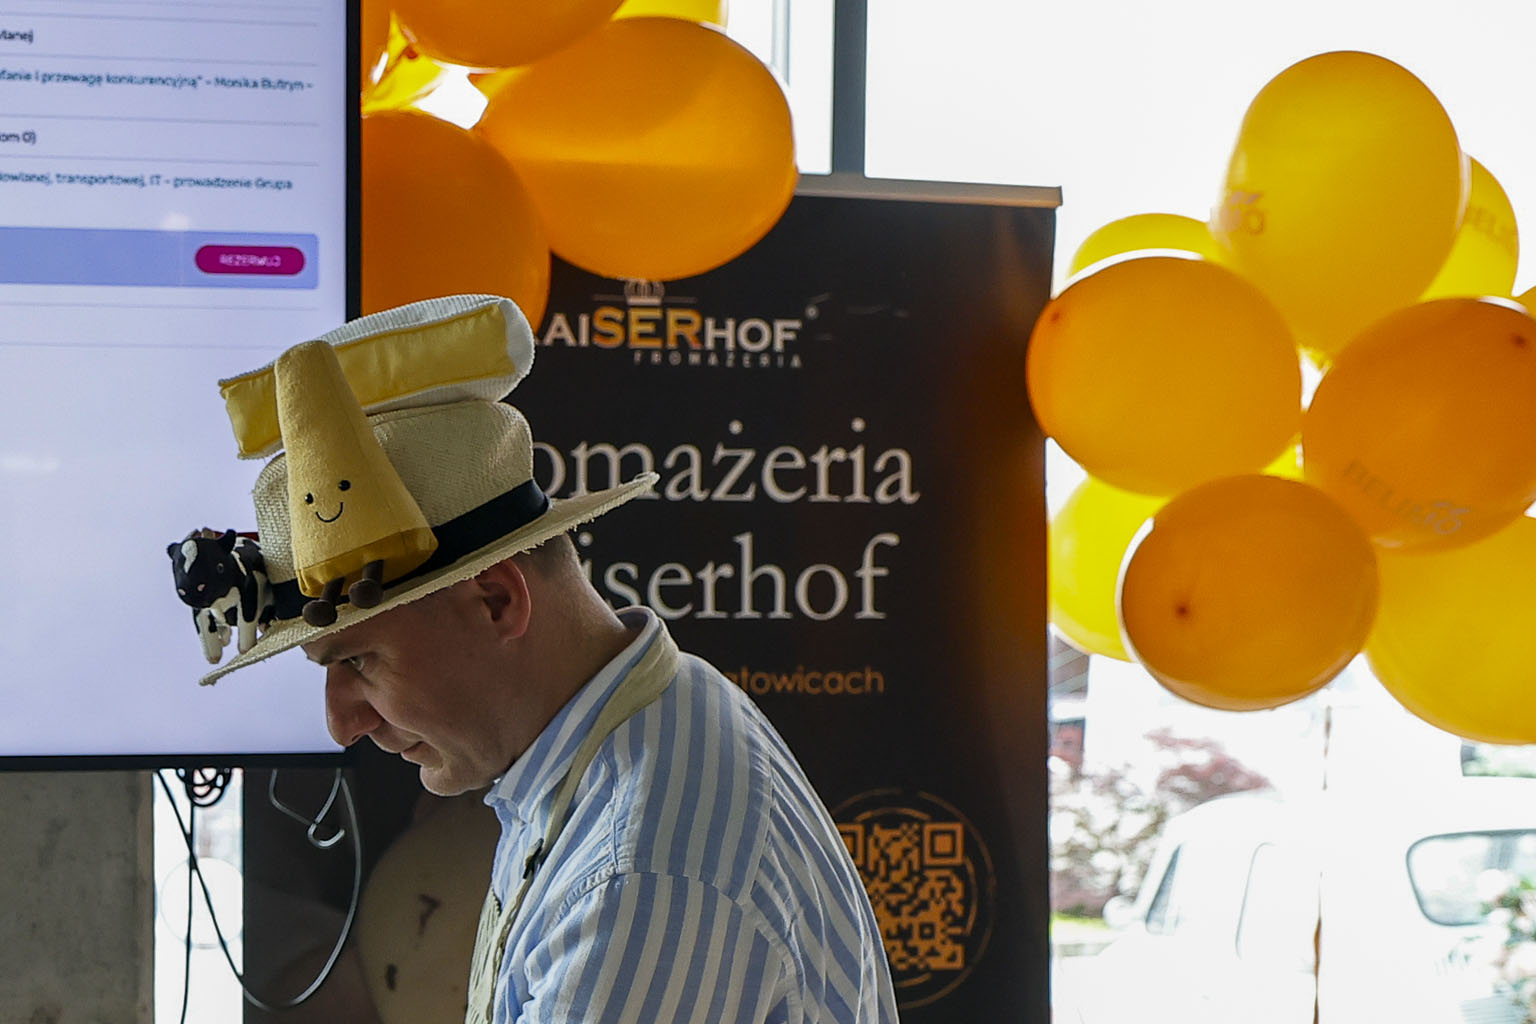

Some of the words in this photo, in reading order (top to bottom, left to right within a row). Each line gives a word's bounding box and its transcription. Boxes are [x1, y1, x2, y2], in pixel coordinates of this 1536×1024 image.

[42, 73, 103, 87] przewagę
[214, 78, 258, 88] Monika
[173, 177, 252, 188] prowadzenie
[255, 178, 292, 191] Grupa
[537, 306, 803, 353] AISERHOF
[532, 417, 921, 506] omażeria
[578, 531, 901, 622] iserhof
[724, 664, 885, 695] towicach
